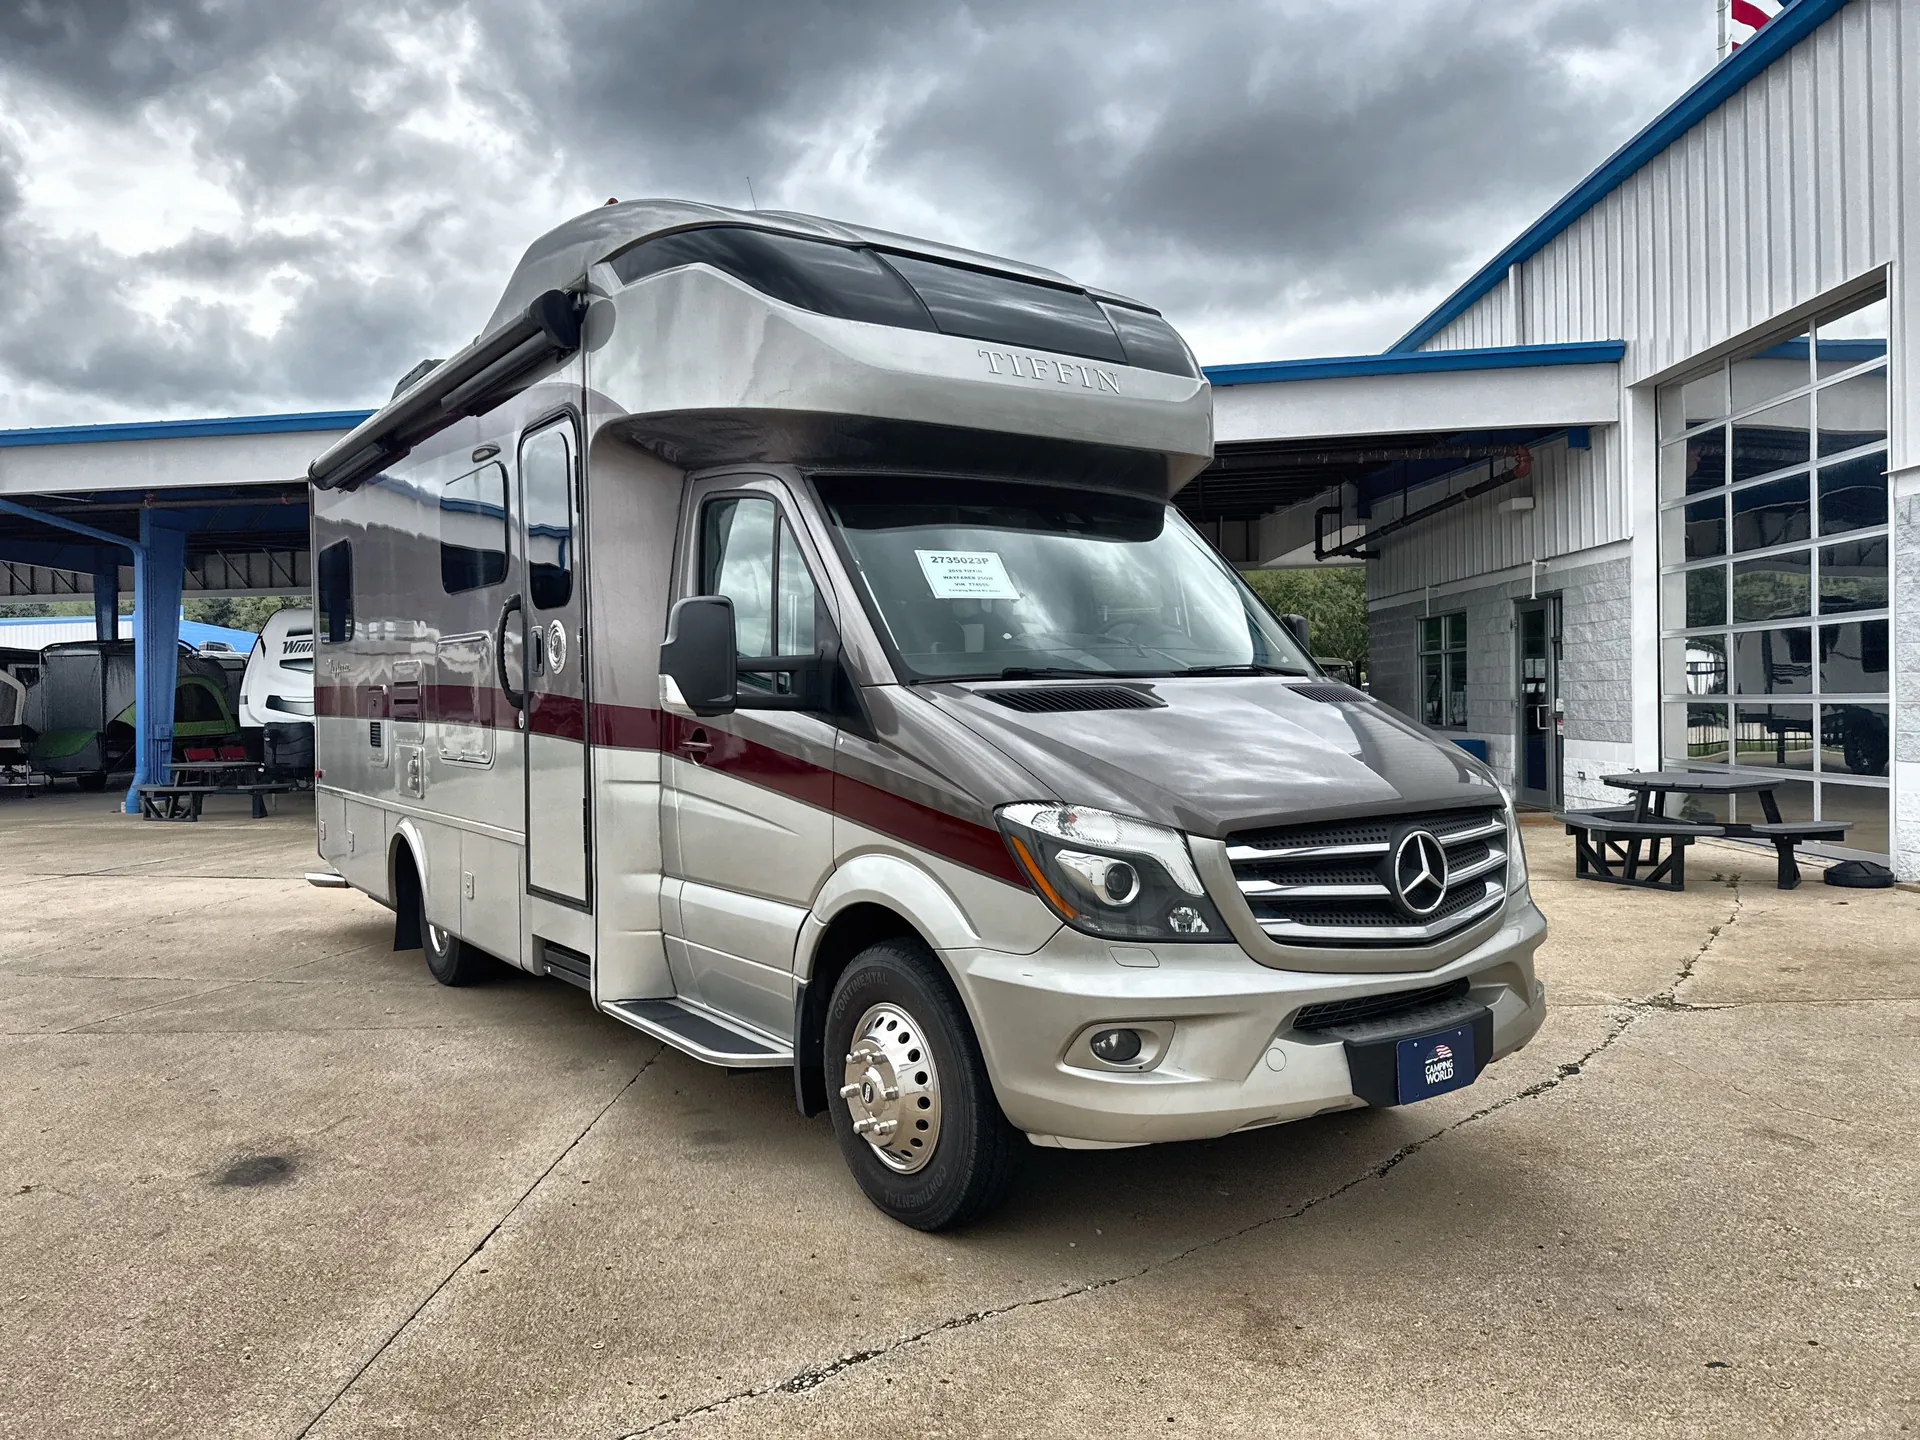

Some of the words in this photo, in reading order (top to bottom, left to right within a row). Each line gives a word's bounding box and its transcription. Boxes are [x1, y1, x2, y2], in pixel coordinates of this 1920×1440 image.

[978, 349, 1121, 395] TIFFIN
[931, 556, 989, 564] 2735023P
[834, 971, 889, 1020] CONTINENTAL
[1425, 1059, 1453, 1074] CAMPING
[1426, 1068, 1453, 1084] WORLD
[884, 1164, 947, 1209] CONTINENTAL
